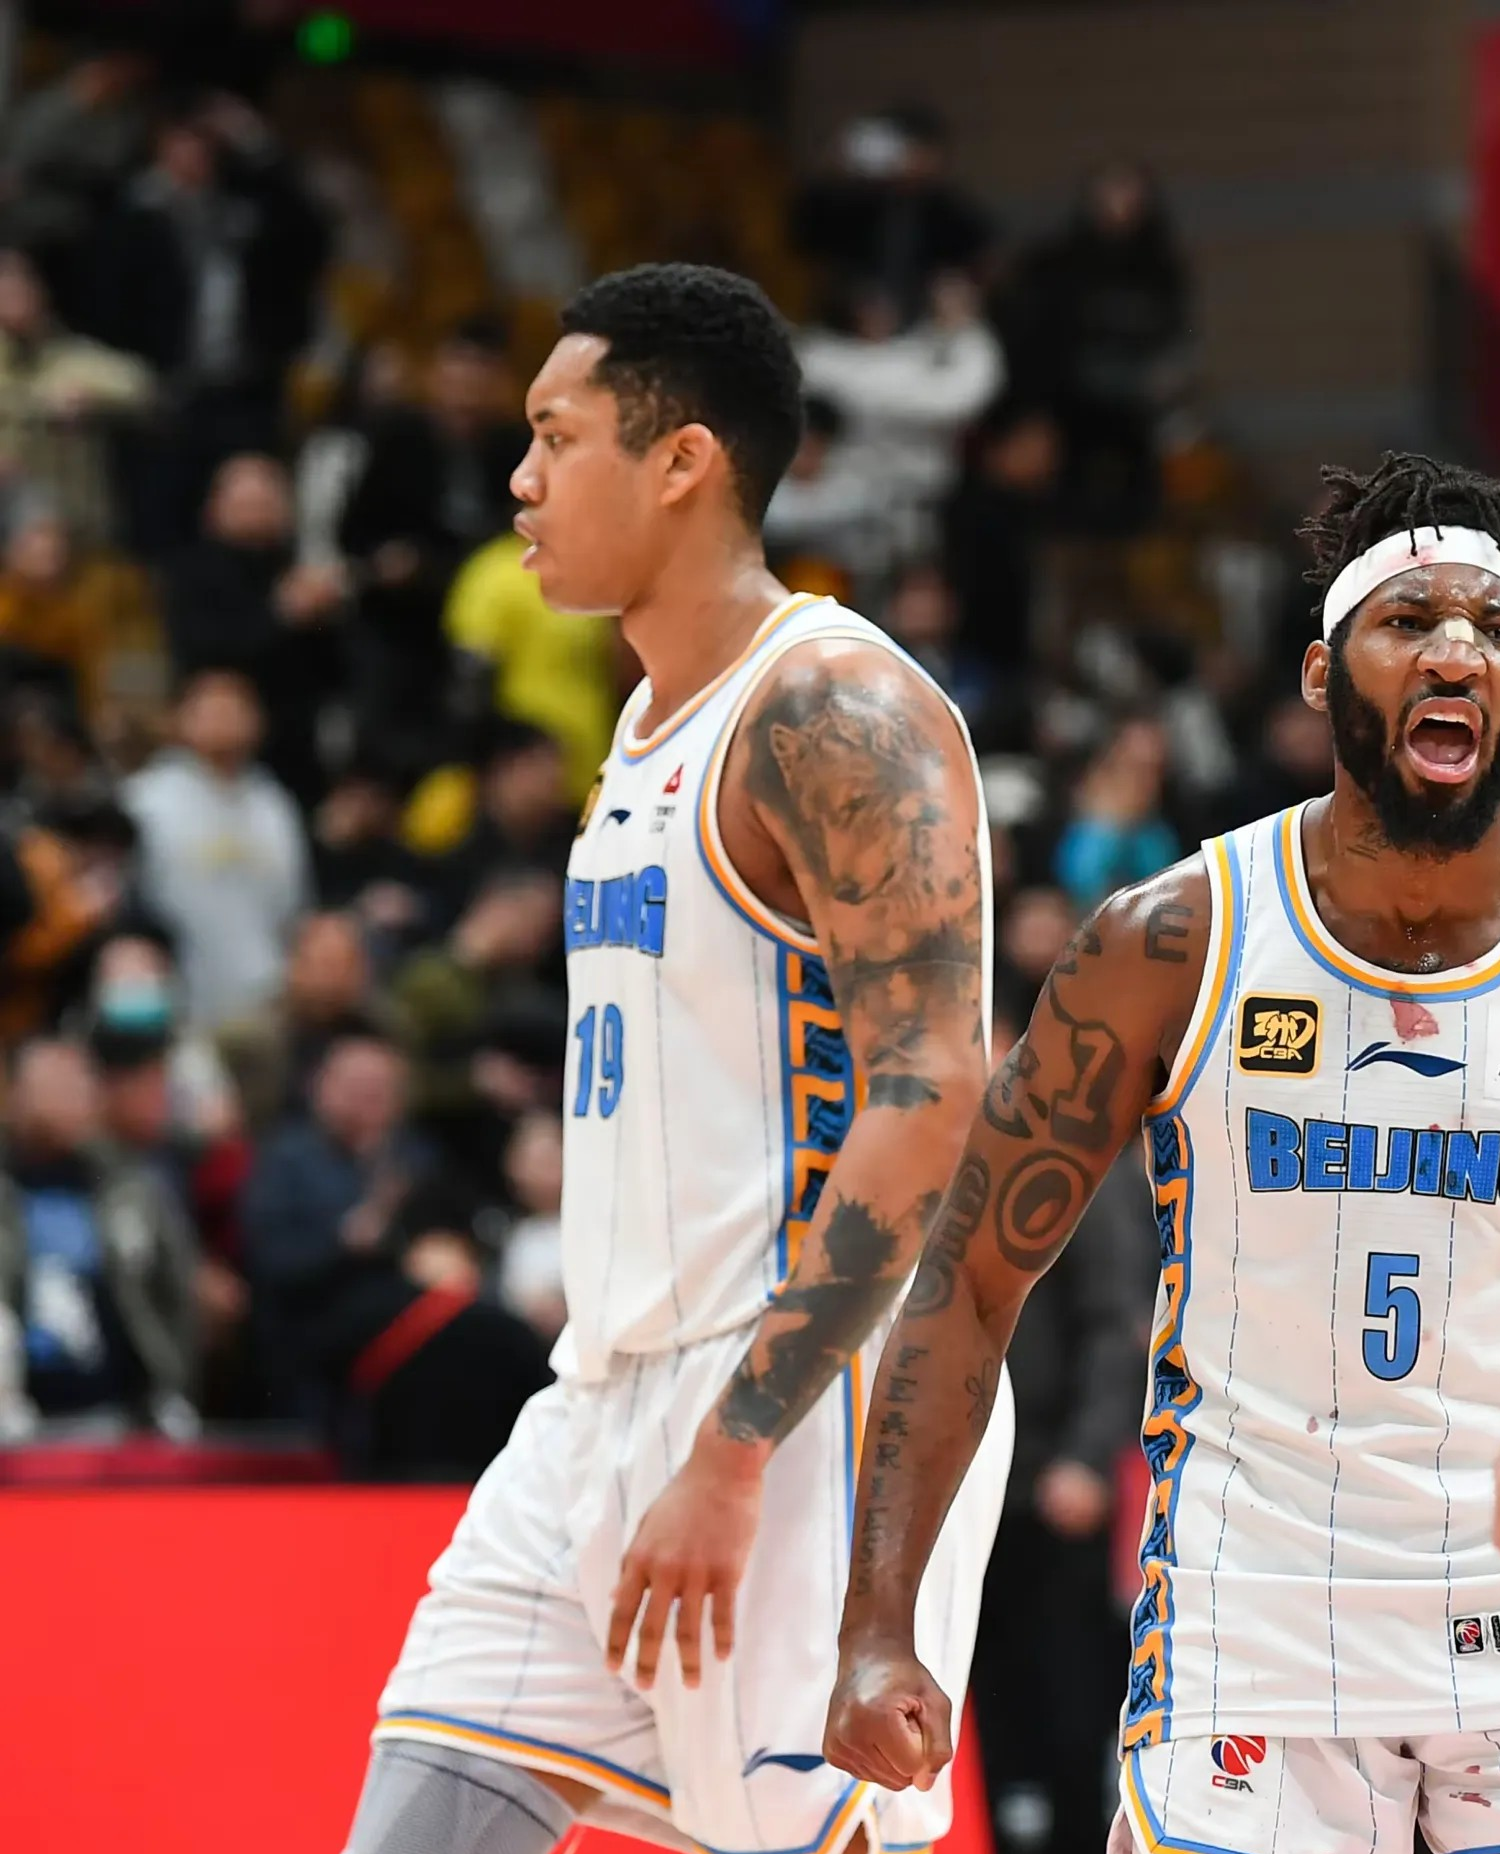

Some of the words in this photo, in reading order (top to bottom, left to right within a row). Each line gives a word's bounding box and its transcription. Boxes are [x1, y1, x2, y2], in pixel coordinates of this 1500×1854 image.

[573, 1003, 624, 1120] 19
[1361, 1251, 1421, 1382] 5
[1212, 1775, 1254, 1793] CBA
